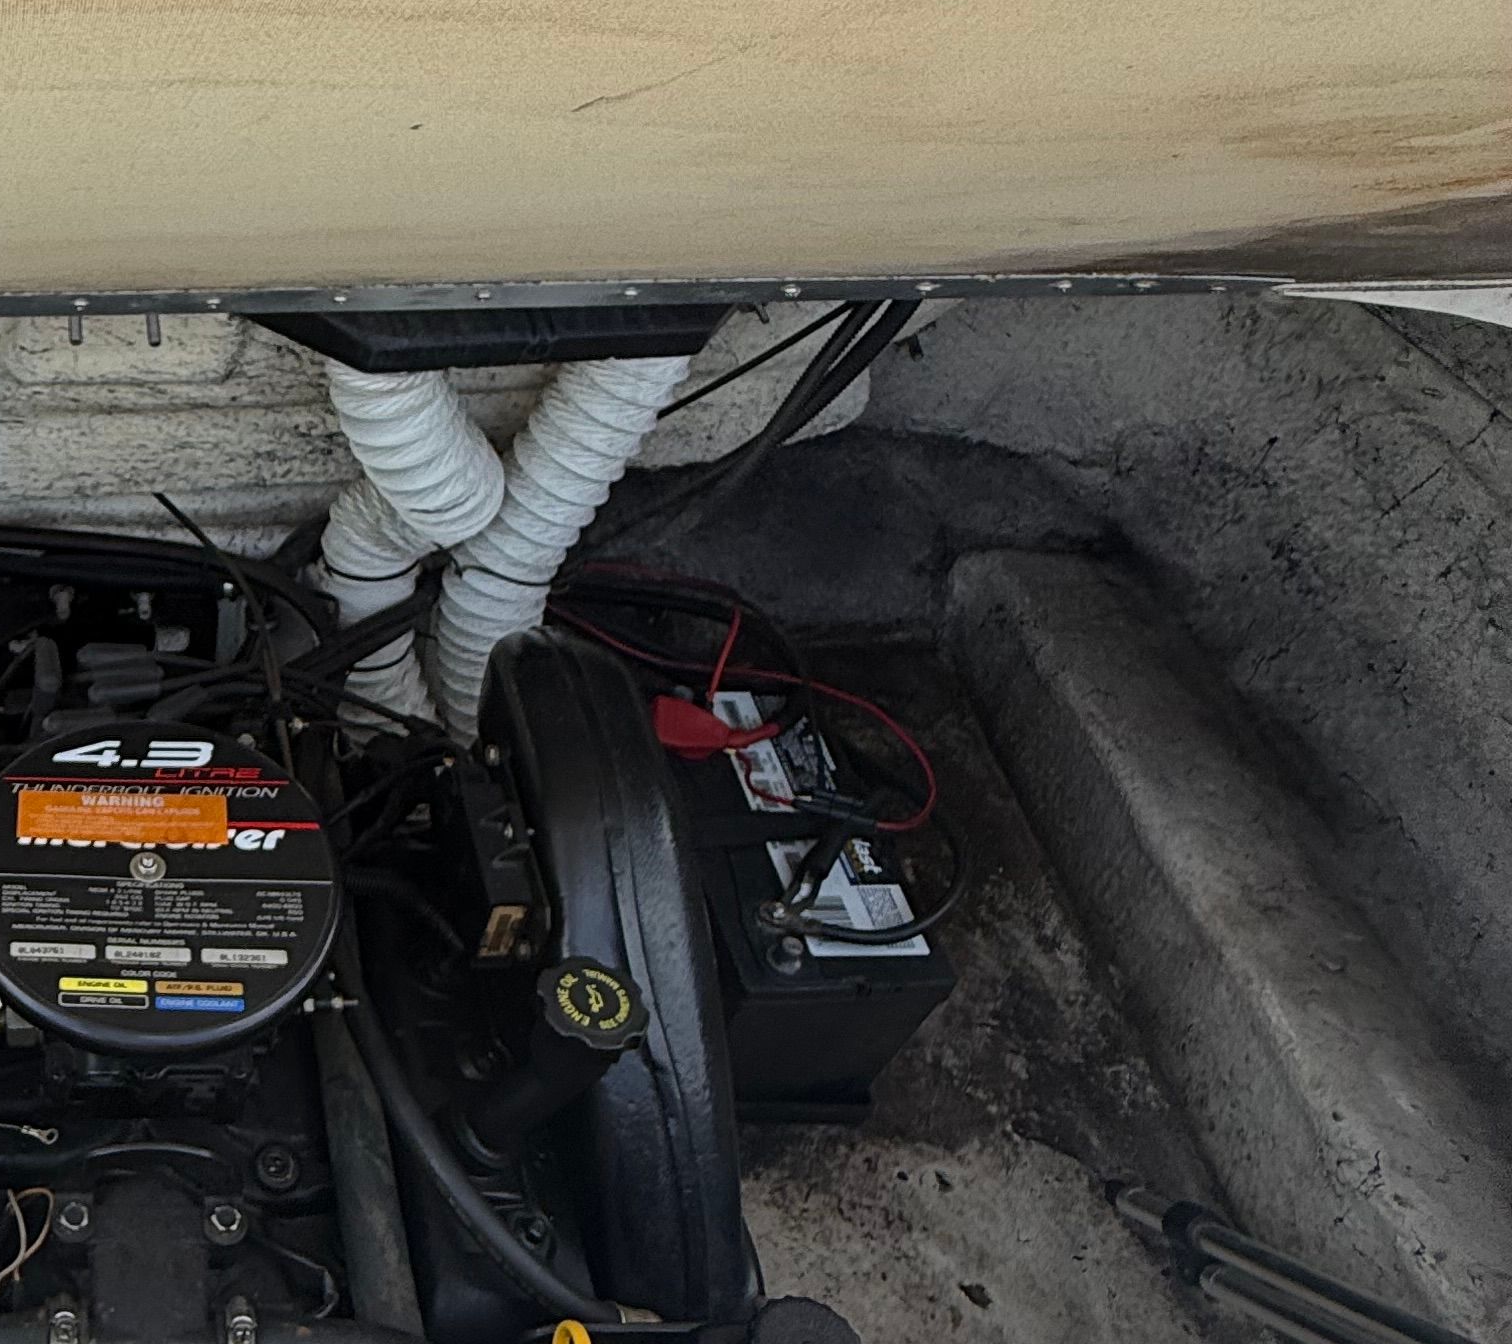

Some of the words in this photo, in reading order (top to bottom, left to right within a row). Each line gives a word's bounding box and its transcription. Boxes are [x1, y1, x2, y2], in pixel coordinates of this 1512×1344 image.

[52, 740, 214, 768] 4.3
[155, 767, 263, 779] LITRE
[179, 786, 280, 799] IGNITION
[81, 795, 165, 808] WARNING
[556, 986, 591, 1027] ENGINE
